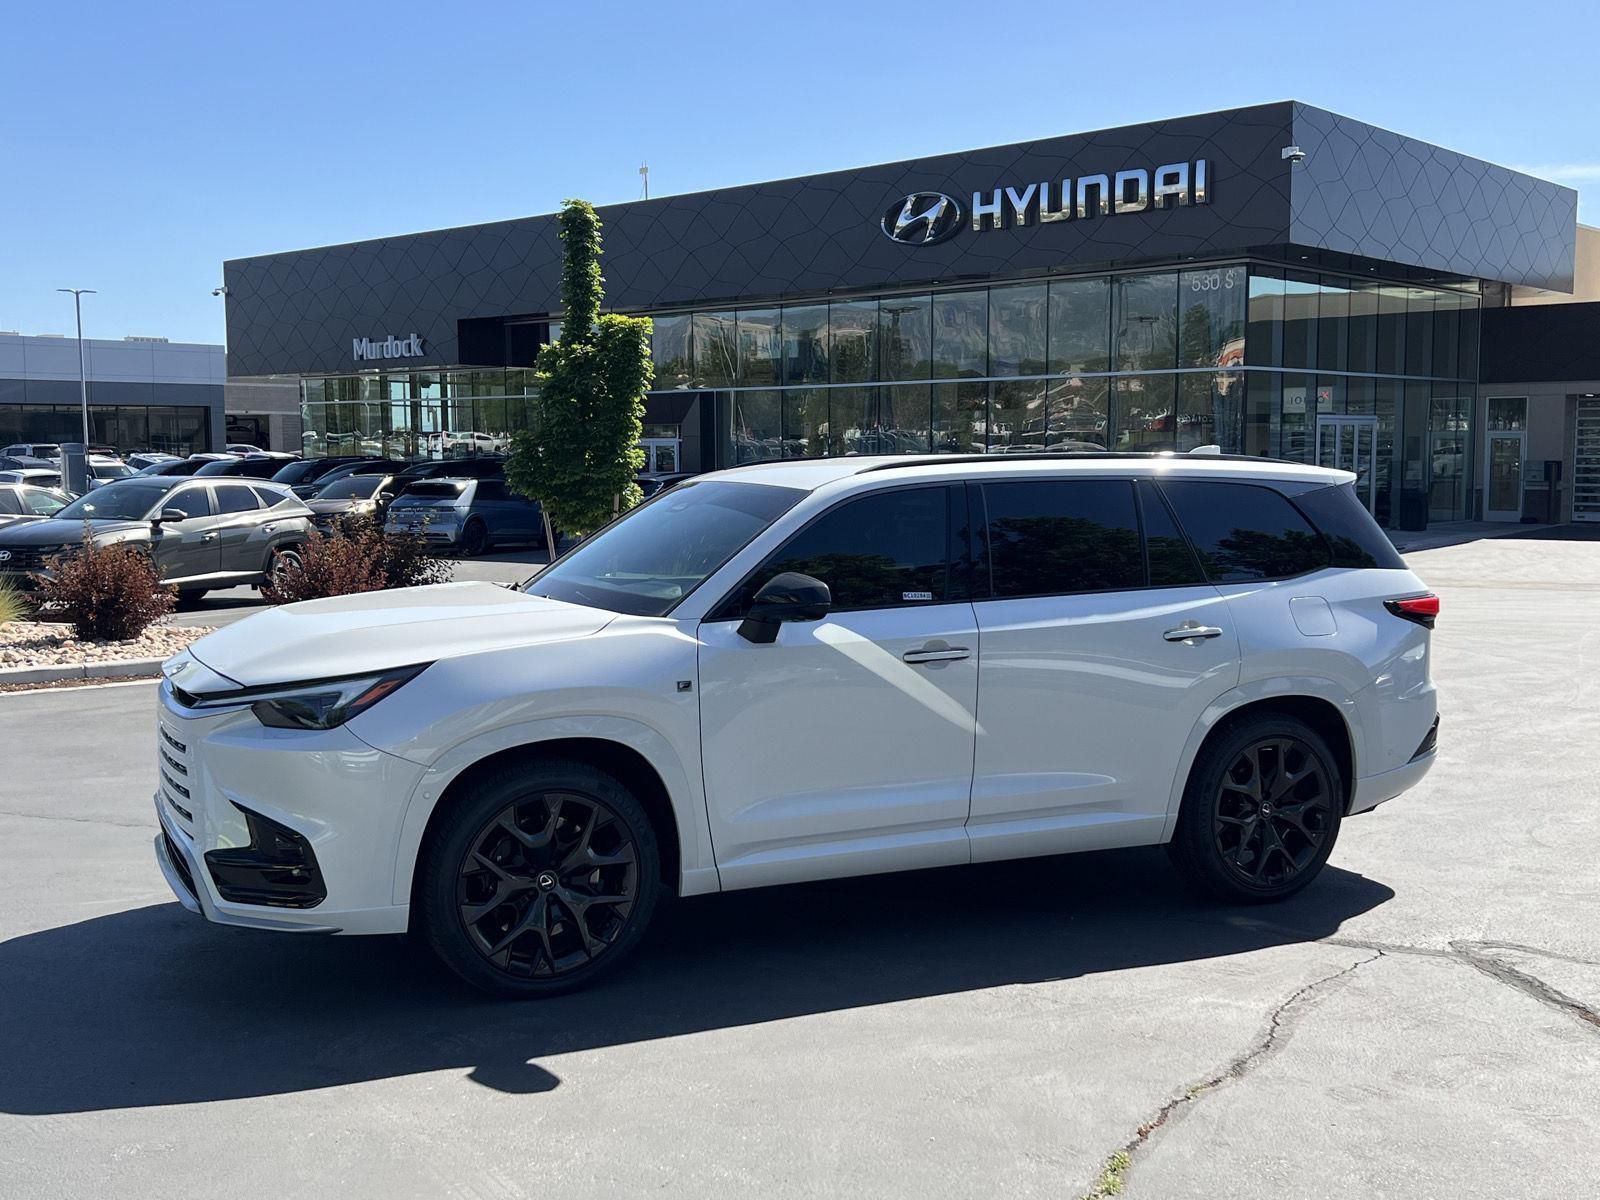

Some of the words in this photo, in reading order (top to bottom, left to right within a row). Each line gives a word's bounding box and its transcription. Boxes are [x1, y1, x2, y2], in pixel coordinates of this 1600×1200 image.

[972, 159, 1206, 231] HYUNDAI
[1192, 274, 1220, 291] 530
[1225, 271, 1234, 289] S
[353, 333, 424, 361] Murdock
